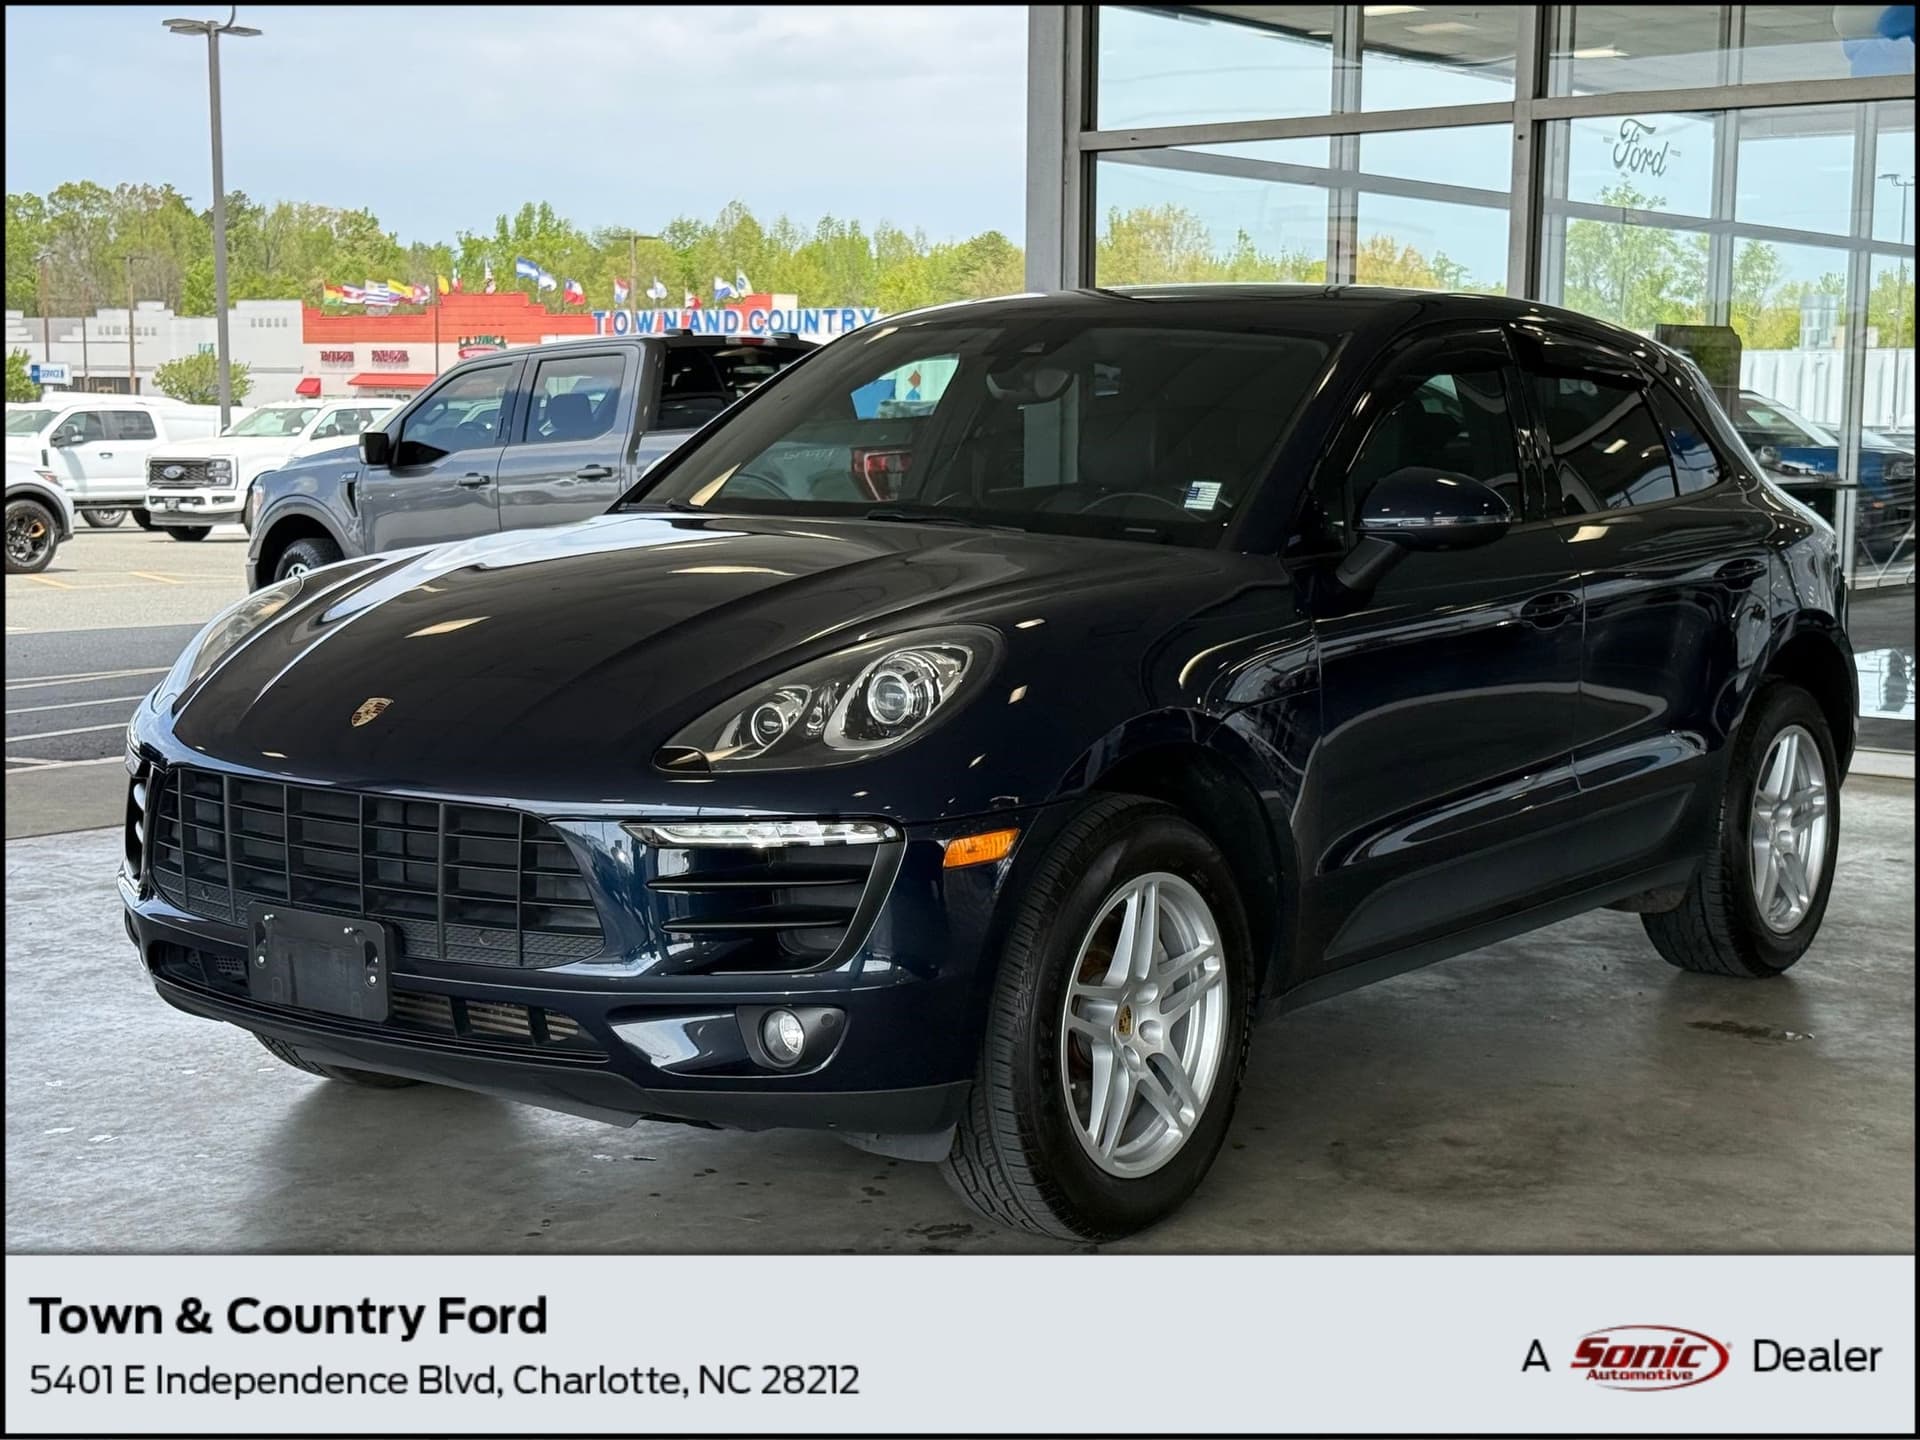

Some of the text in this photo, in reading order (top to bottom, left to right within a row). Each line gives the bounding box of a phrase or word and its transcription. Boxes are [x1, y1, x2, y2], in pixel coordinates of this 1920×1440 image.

[1613, 118, 1669, 177] Ford
[592, 309, 876, 335] TOWN AND COUNTRY
